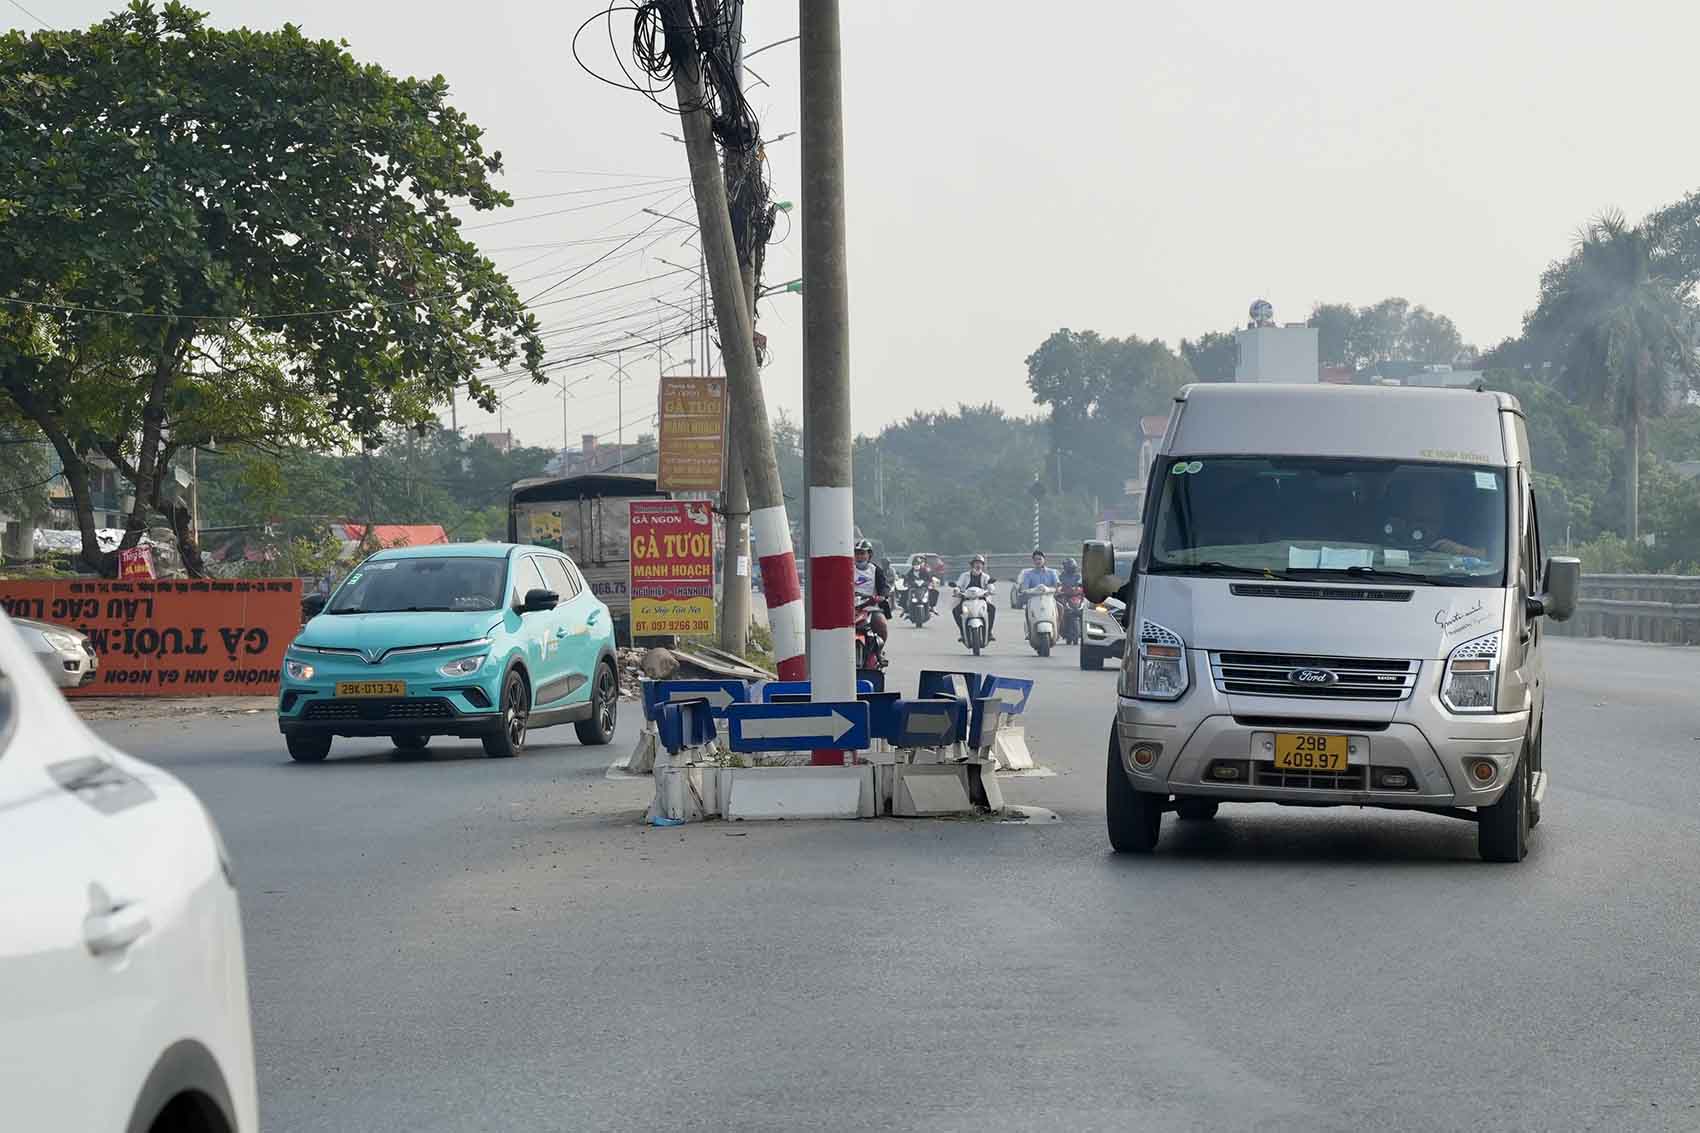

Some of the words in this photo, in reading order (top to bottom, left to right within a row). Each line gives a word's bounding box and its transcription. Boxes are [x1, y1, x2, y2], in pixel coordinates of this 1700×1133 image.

[632, 515, 649, 524] GÀ
[651, 516, 682, 524] NGON
[633, 528, 660, 559] GÀ
[663, 532, 711, 558] TƯƠI
[0, 594, 44, 618] LOẠ
[52, 598, 99, 621] CÁC
[219, 627, 268, 661] GÀ
[104, 669, 152, 684] NGON
[157, 669, 179, 687] GÀ
[185, 669, 218, 684] ANH
[1298, 670, 1327, 682] Ford
[1295, 736, 1327, 751] 29B
[1283, 752, 1339, 769] 409.97
